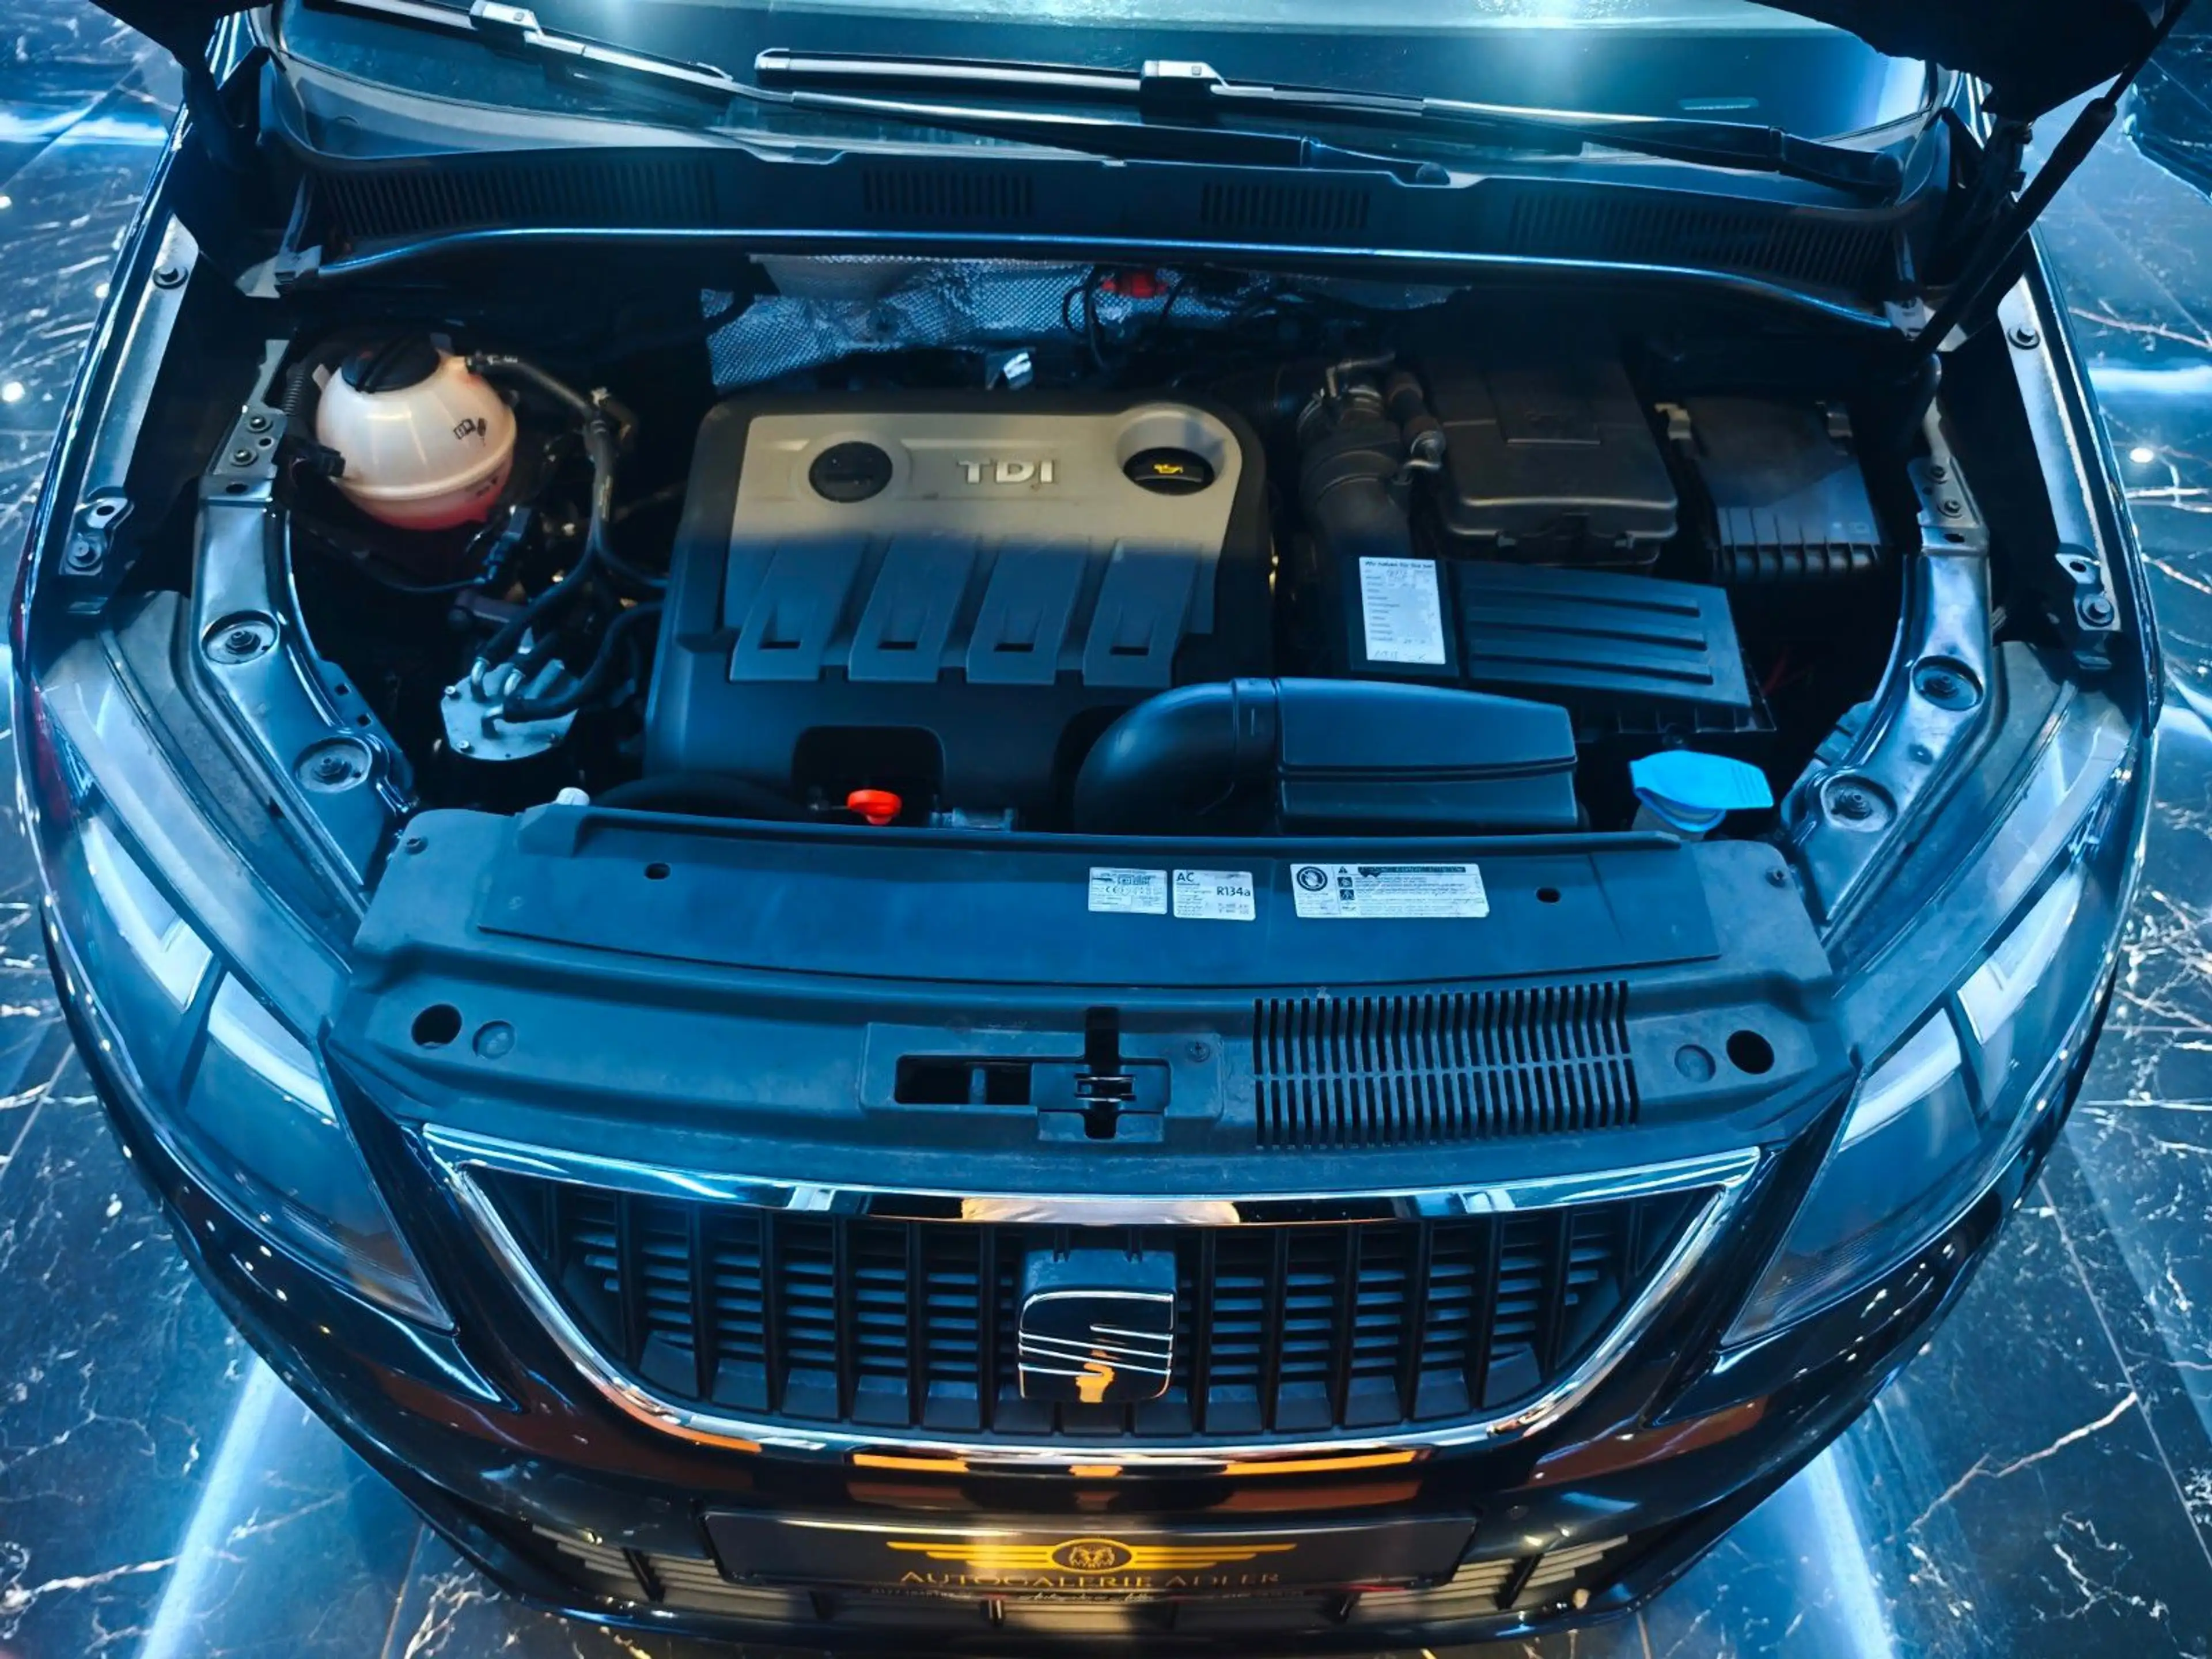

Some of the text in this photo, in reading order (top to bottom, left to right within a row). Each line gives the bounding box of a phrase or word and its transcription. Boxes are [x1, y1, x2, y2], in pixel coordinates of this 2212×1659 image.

[957, 459, 1054, 484] TDI
[1176, 872, 1195, 882] AC
[1216, 886, 1251, 897] R134a
[900, 1570, 1152, 1588] AUTOGALERIE
